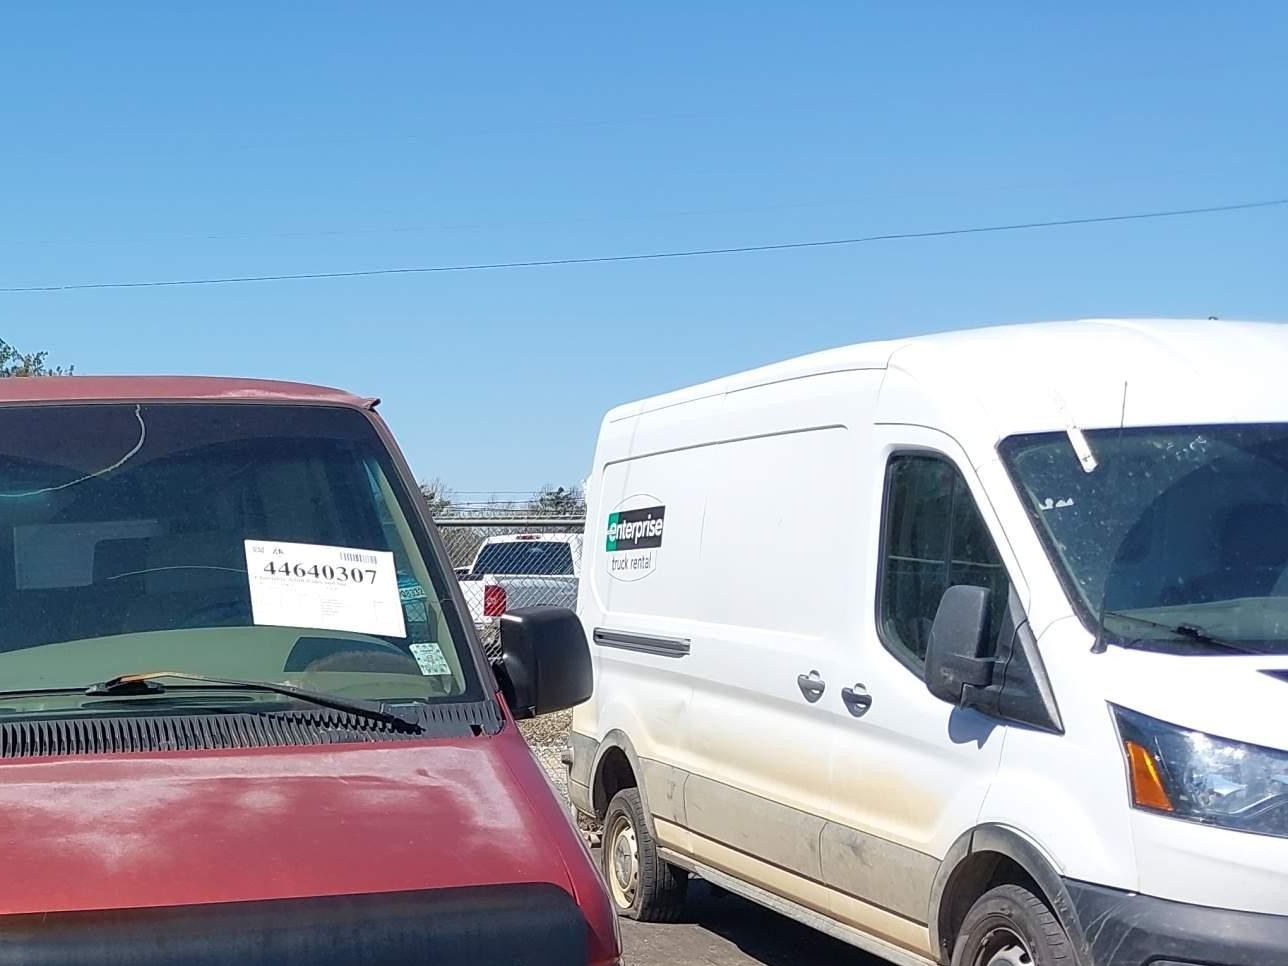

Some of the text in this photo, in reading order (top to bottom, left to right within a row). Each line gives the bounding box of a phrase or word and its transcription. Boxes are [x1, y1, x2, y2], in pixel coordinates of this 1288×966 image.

[608, 514, 663, 544] enterprise
[263, 560, 377, 585] 44640307
[612, 552, 652, 571] truck rental
